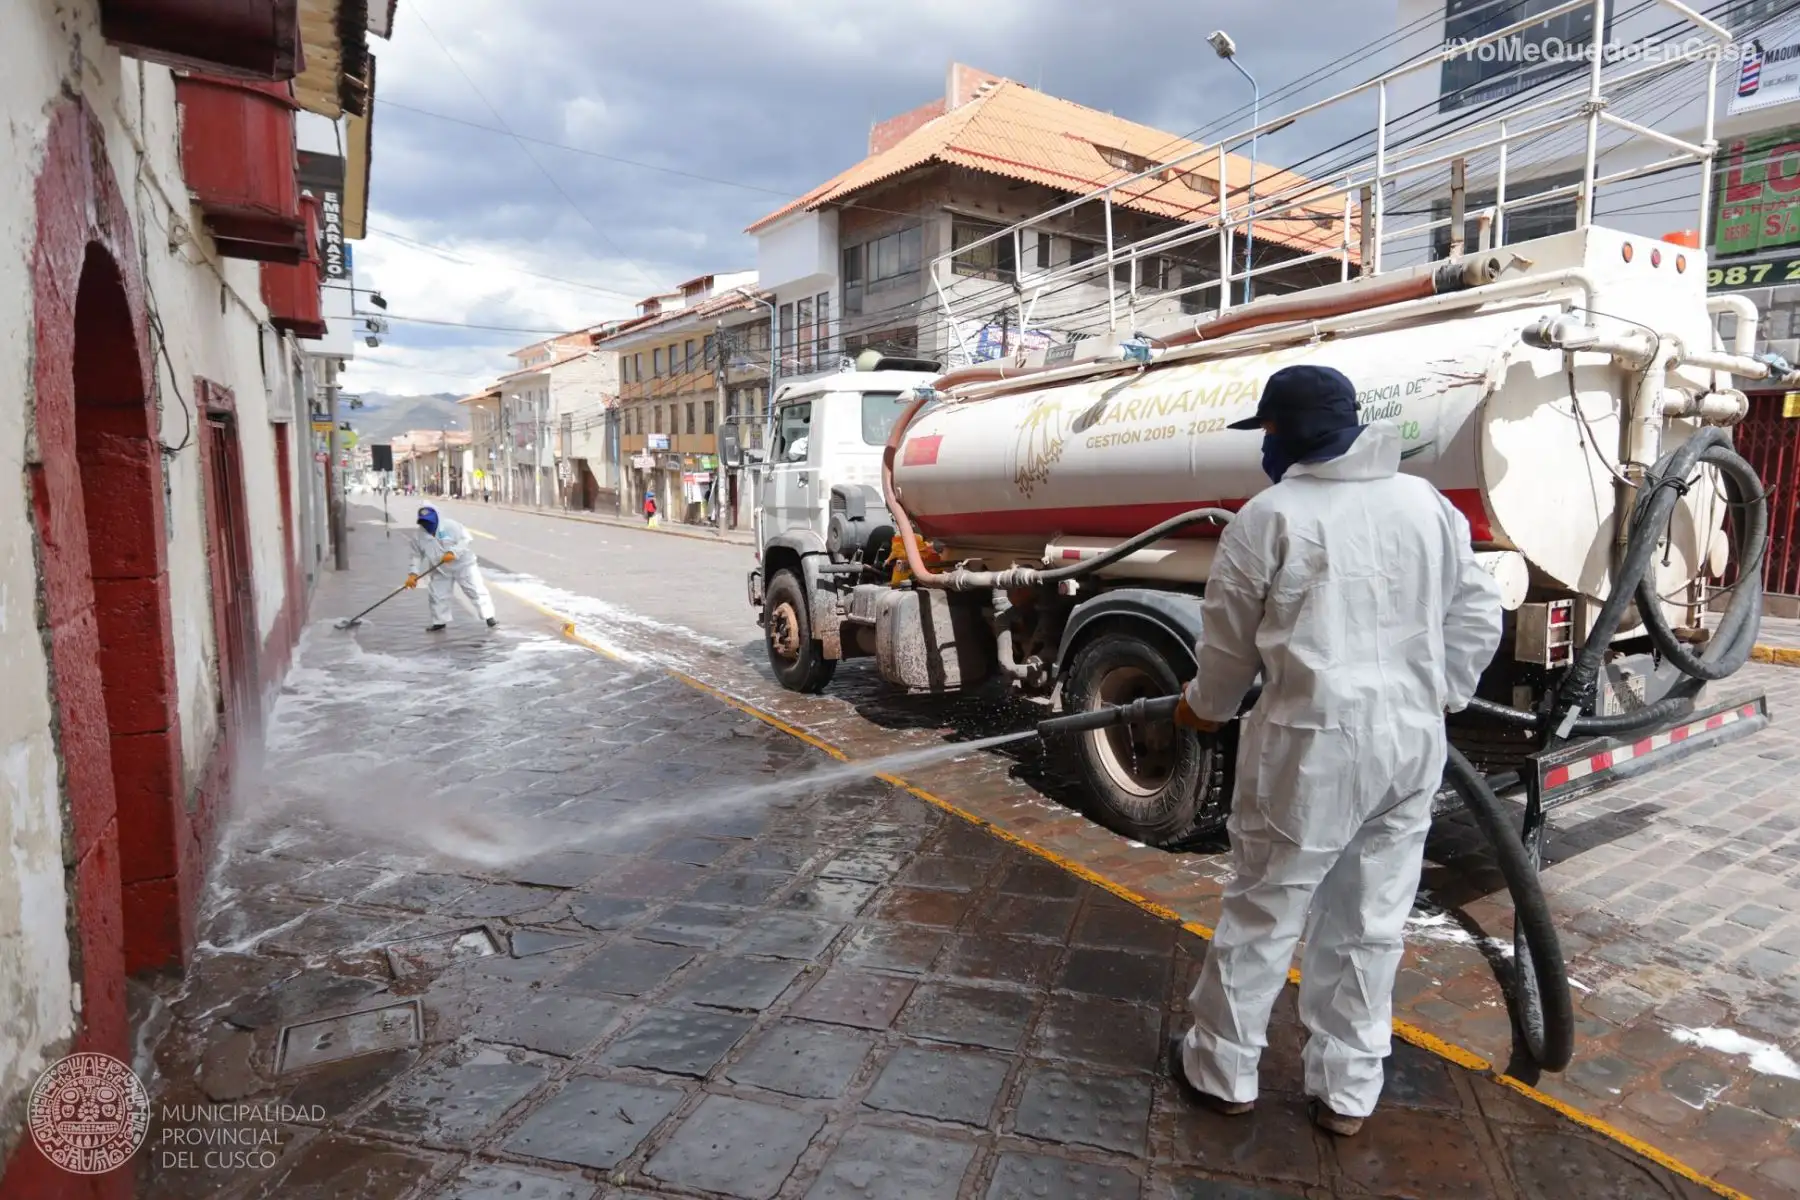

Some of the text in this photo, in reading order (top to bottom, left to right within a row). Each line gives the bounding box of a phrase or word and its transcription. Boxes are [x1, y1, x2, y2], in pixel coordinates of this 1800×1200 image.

[323, 191, 342, 274] EMBARAZO
[1707, 264, 1772, 287] 987
[1358, 384, 1400, 404] RENCIA
[1361, 401, 1402, 424] Medio
[1086, 429, 1141, 449] GESTIÓN
[1143, 425, 1175, 441] 2019
[1187, 417, 1226, 435] 2022
